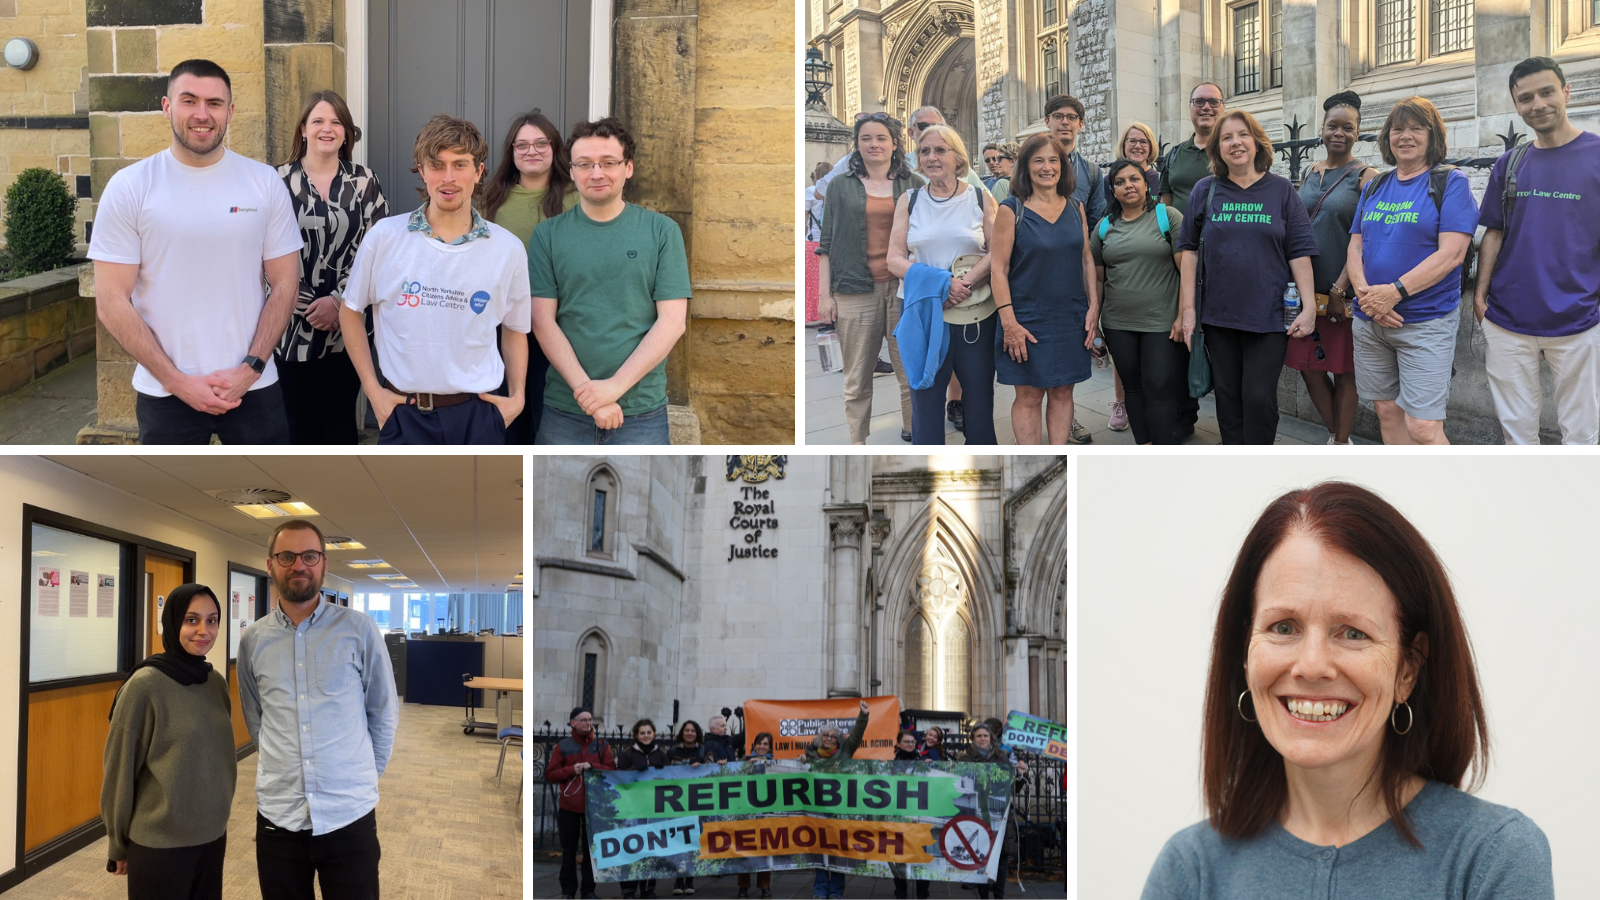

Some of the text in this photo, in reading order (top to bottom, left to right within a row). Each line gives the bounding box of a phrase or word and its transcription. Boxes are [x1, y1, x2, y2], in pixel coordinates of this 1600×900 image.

[1533, 188, 1551, 198] Law
[1552, 191, 1581, 200] Centre
[1222, 202, 1264, 212] HARROW
[1376, 200, 1414, 212] HARROW
[1212, 212, 1272, 224] LAW CENTRE
[1363, 212, 1384, 222] LAW
[440, 288, 464, 296] Yorkshire
[421, 298, 466, 310] Law Centre
[740, 486, 770, 500] The
[733, 500, 775, 517] Royal
[730, 516, 778, 530] Courts
[744, 529, 762, 544] of
[728, 544, 778, 562] Justice
[798, 718, 856, 728] Public Intere
[798, 728, 816, 736] Law
[870, 738, 894, 748] ACTION
[1008, 732, 1046, 746] DON'T
[775, 742, 790, 750] LAW
[654, 777, 929, 814] REFURBISH
[600, 823, 904, 859] DON'T DEMOLISH
